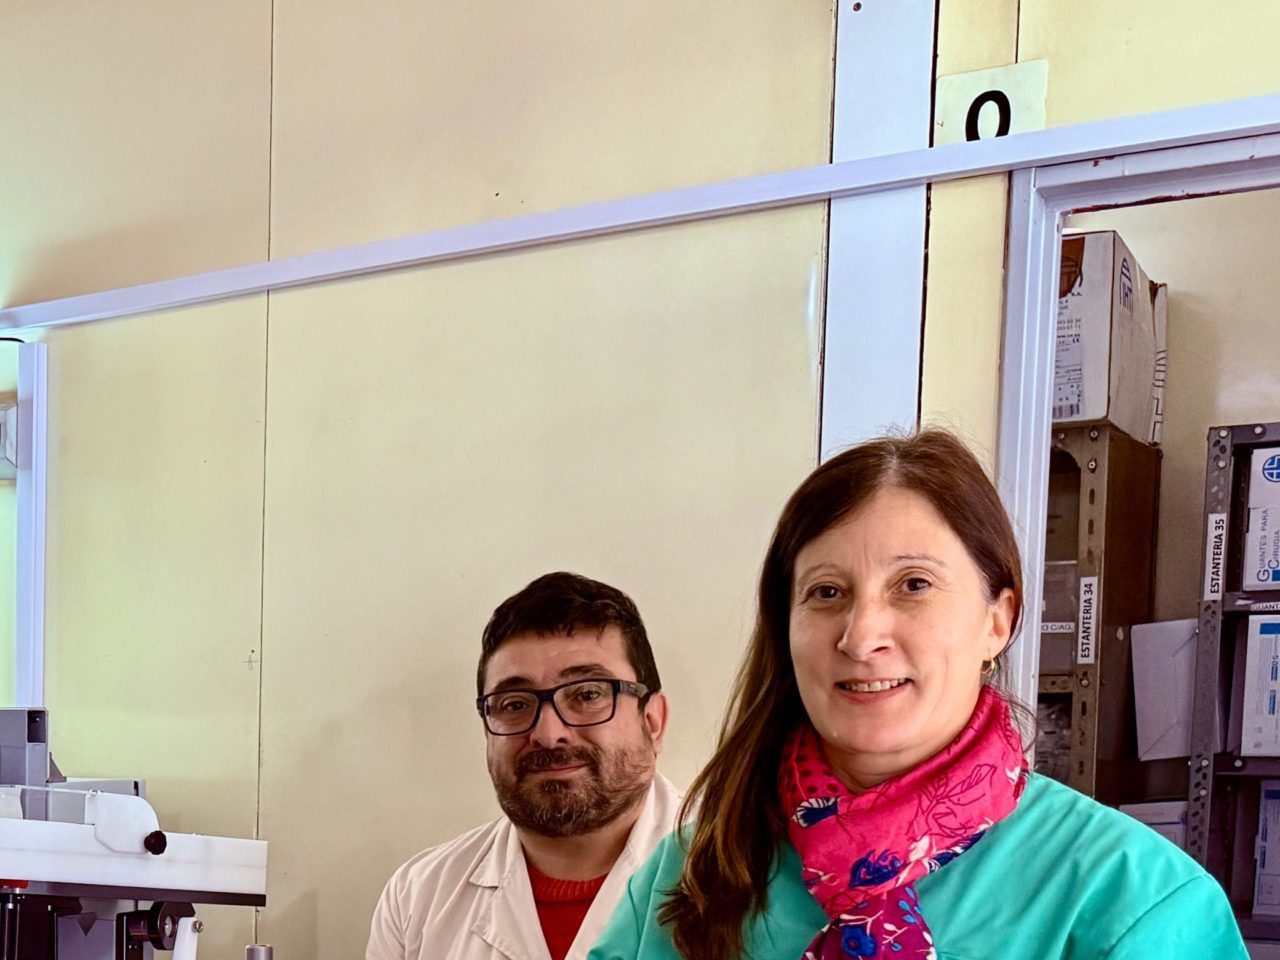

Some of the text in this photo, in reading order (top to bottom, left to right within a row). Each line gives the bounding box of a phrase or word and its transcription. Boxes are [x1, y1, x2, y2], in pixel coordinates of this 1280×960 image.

[1211, 518, 1224, 594] ESTANTERIA 35
[1081, 583, 1093, 658] ESTANTERIA 34
